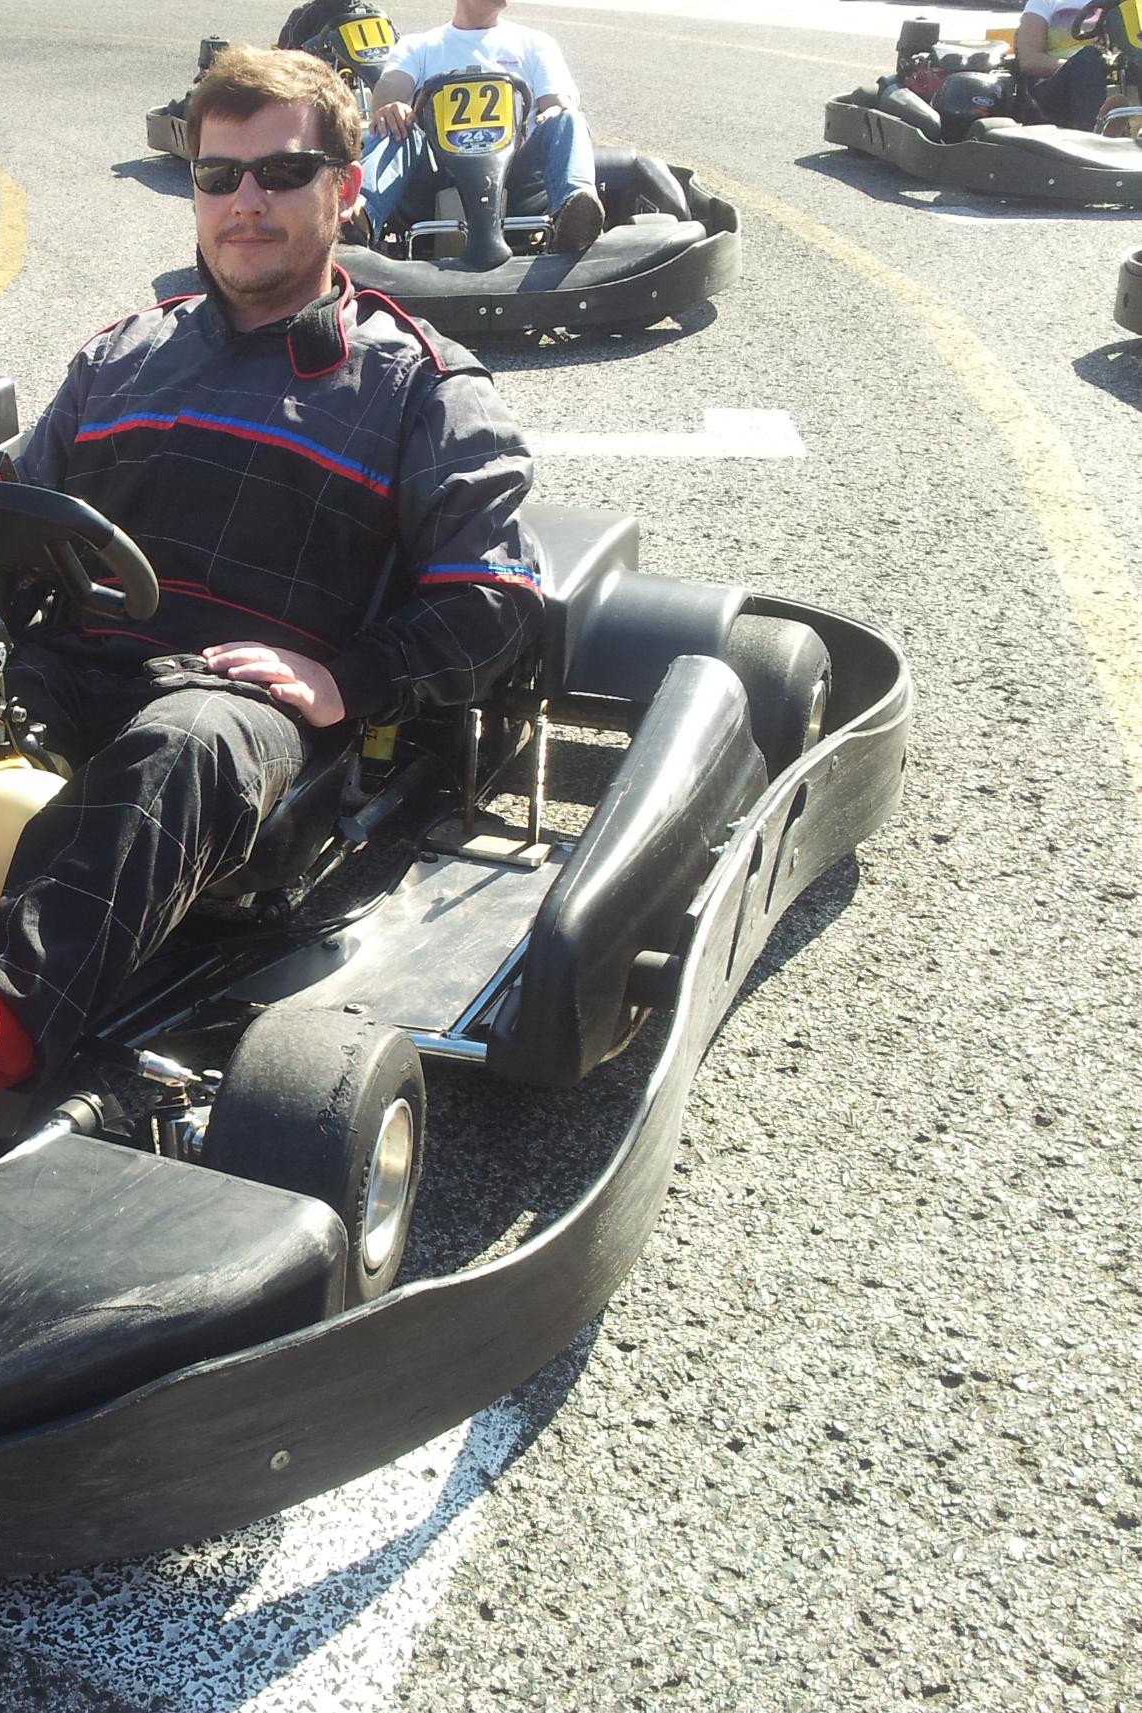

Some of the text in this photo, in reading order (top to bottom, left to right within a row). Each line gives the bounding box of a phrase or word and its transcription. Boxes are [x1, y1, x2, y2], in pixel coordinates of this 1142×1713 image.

[358, 21, 386, 47] 11
[450, 85, 500, 125] 22
[462, 131, 484, 142] 24
